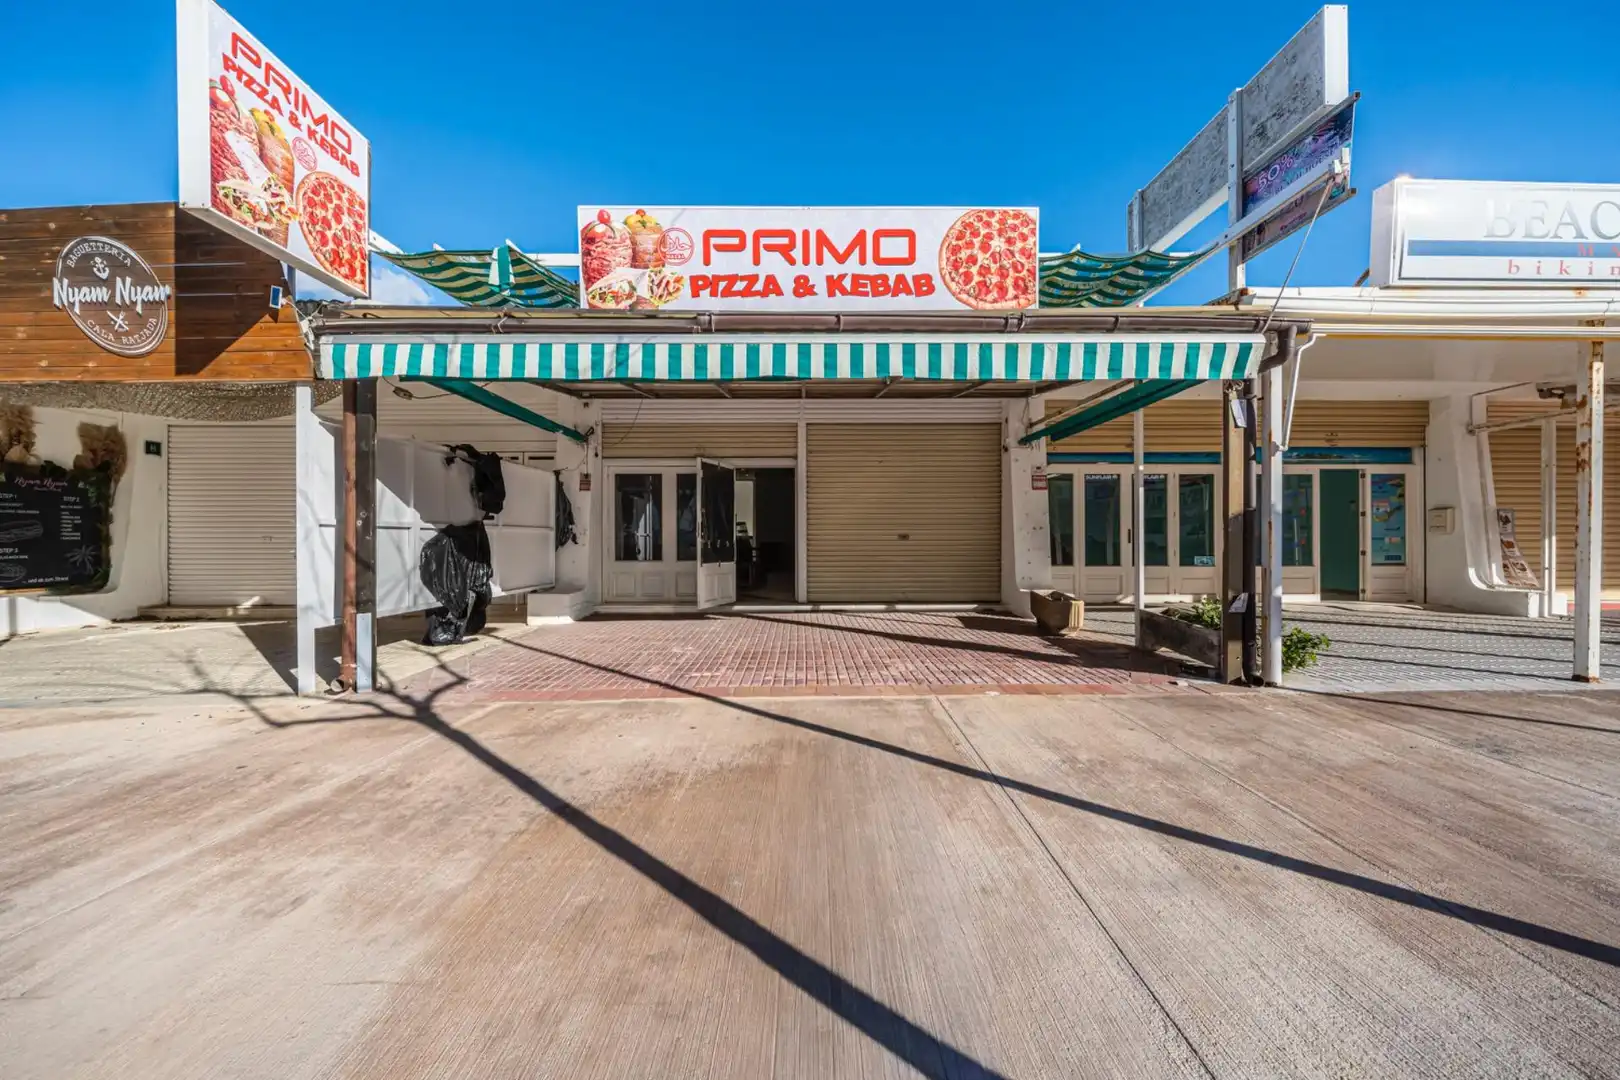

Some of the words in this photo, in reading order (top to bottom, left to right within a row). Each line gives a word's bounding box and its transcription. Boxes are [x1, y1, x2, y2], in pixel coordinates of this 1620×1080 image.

[231, 32, 352, 155] PRIMO
[222, 52, 284, 117] PIZZA
[288, 110, 302, 132] &
[307, 124, 360, 177] KEBAB
[1257, 154, 1294, 193] 50%
[66, 242, 132, 268] BAGUETTERIA
[702, 229, 916, 267] PRIMO
[52, 277, 112, 316] Nyam
[115, 276, 171, 316] Nyam
[689, 273, 784, 298] PIZZA
[792, 274, 819, 298] &
[825, 273, 936, 298] KEBAB
[87, 319, 116, 342] CALA
[121, 317, 158, 345] RATJADA
